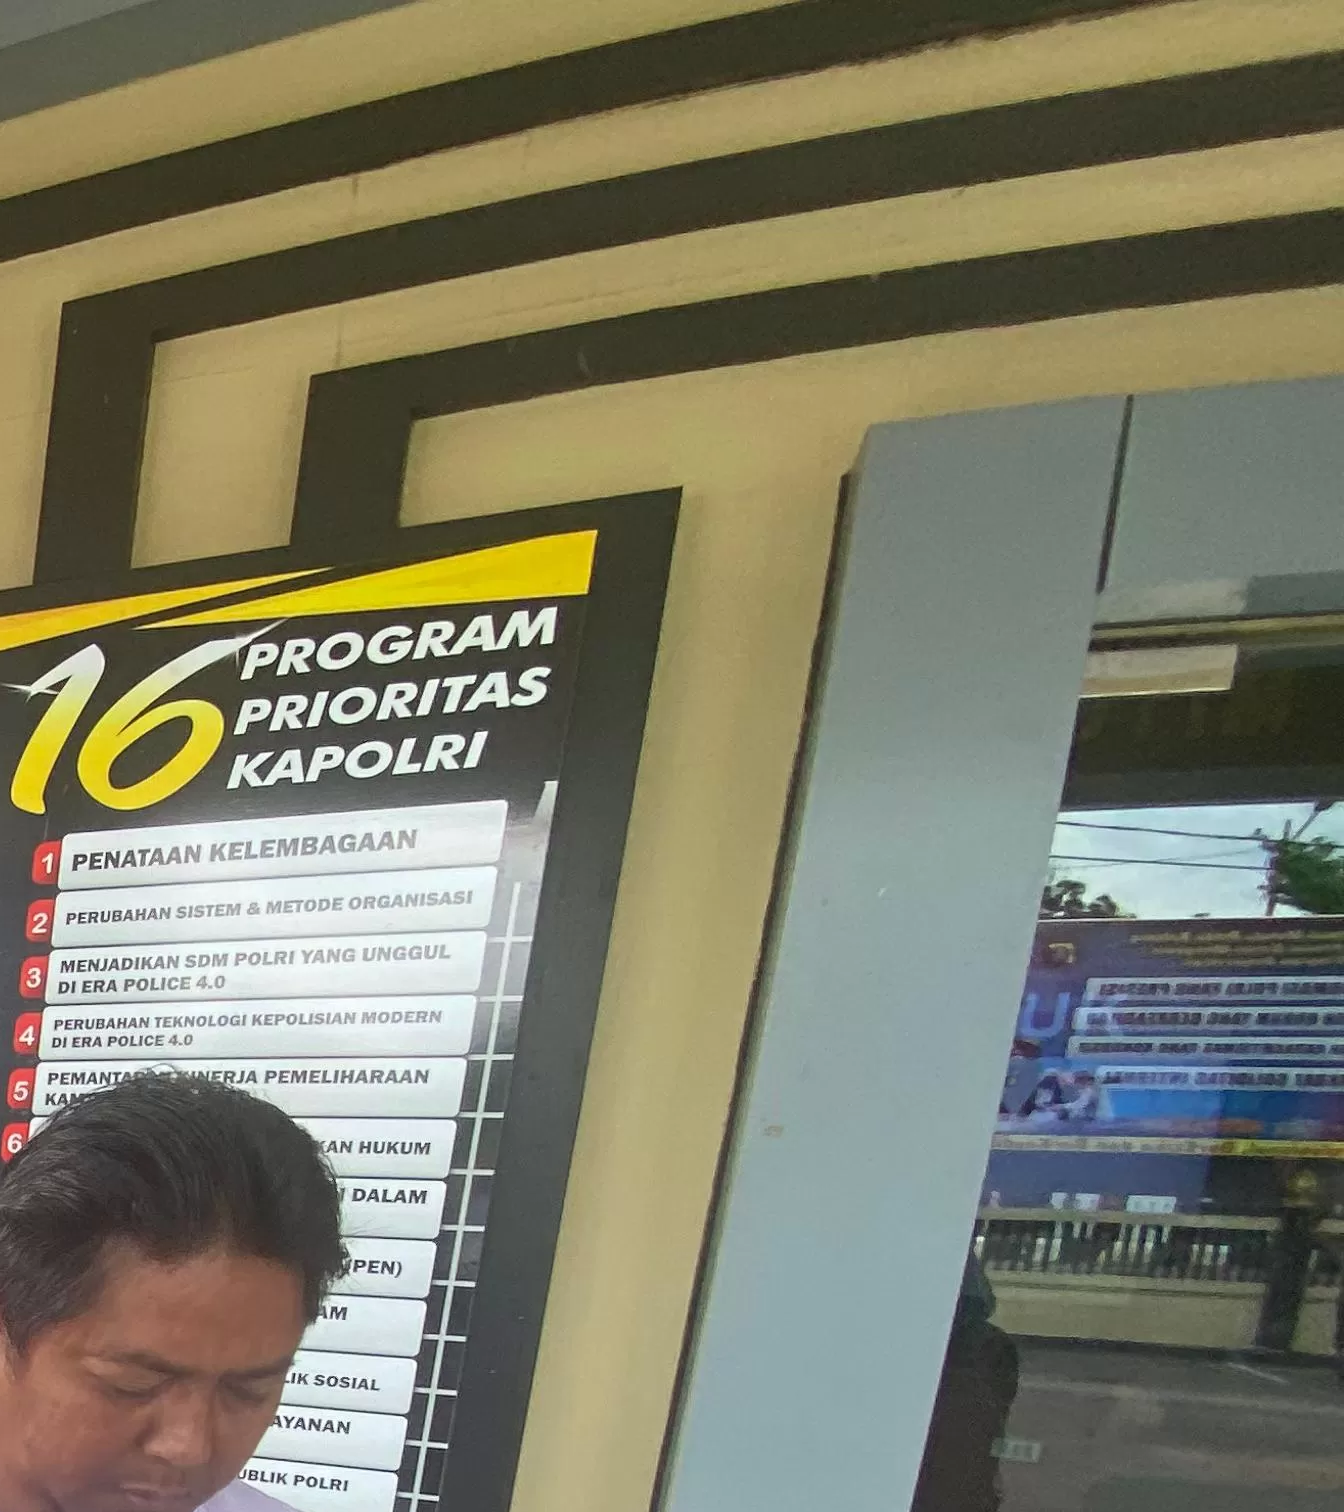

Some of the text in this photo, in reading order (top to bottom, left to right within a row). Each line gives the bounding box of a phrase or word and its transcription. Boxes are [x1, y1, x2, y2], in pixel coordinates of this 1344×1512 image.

[239, 606, 558, 681] PROGRAM
[232, 666, 553, 736] PRIORITAS
[10, 628, 260, 814] 16
[225, 731, 490, 790] KAPOLRI
[41, 828, 419, 874] 1 PENATAAN KELEMBAGAAN
[31, 890, 474, 934] 2 PERUBAHAN SISTEM & METODE ORGANISASI
[25, 944, 452, 989] 3 MENJADIKAN SDM POLRI YANG UNGGUL
[57, 975, 226, 995] DI ERA POLICE 4.0
[18, 1010, 443, 1046] 4 PERUBAHAN TEKNOLOGI KEPOLISIAN MODERN
[51, 1034, 194, 1048] DI ERA POLICE 4.0
[12, 1080, 30, 1102] 5
[263, 1068, 430, 1085] PEMELIHARAAN
[7, 1132, 22, 1154] 6
[358, 1140, 431, 1155] HUKUM
[352, 1188, 428, 1204] DALAM
[313, 1374, 381, 1392] SOSIAL
[293, 1474, 350, 1492] POLRI
